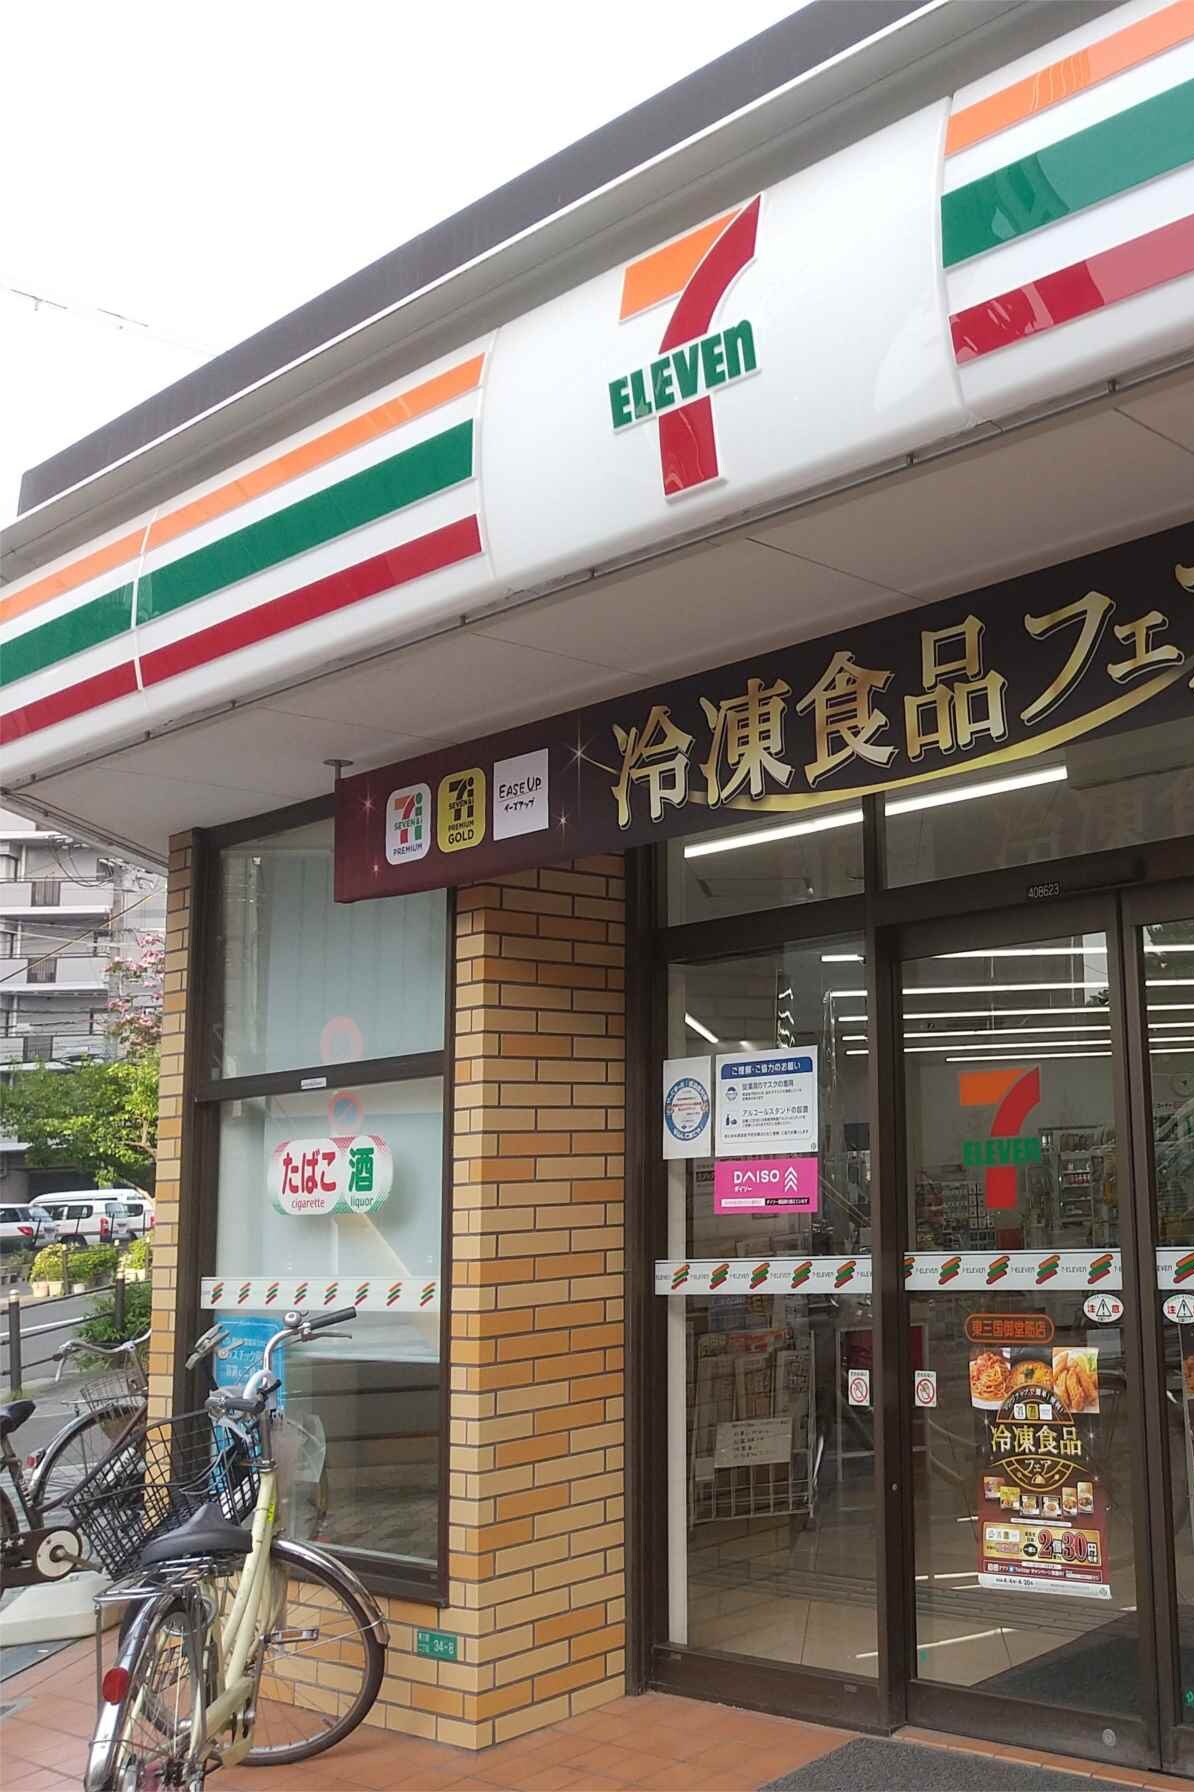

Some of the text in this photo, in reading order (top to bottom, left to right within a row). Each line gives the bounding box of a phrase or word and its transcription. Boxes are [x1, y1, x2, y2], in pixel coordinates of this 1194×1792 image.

[619, 193, 761, 497] 7
[498, 776, 542, 799] EASE UP
[448, 829, 474, 844] GOLD
[393, 842, 423, 857] PREMIUM
[282, 1147, 375, 1195] たばこ 酒
[733, 1169, 780, 1184] DAISO
[291, 1197, 374, 1209] cigarette liquor
[991, 1424, 1083, 1457] 冷凍食品
[1024, 1458, 1051, 1474] フェア
